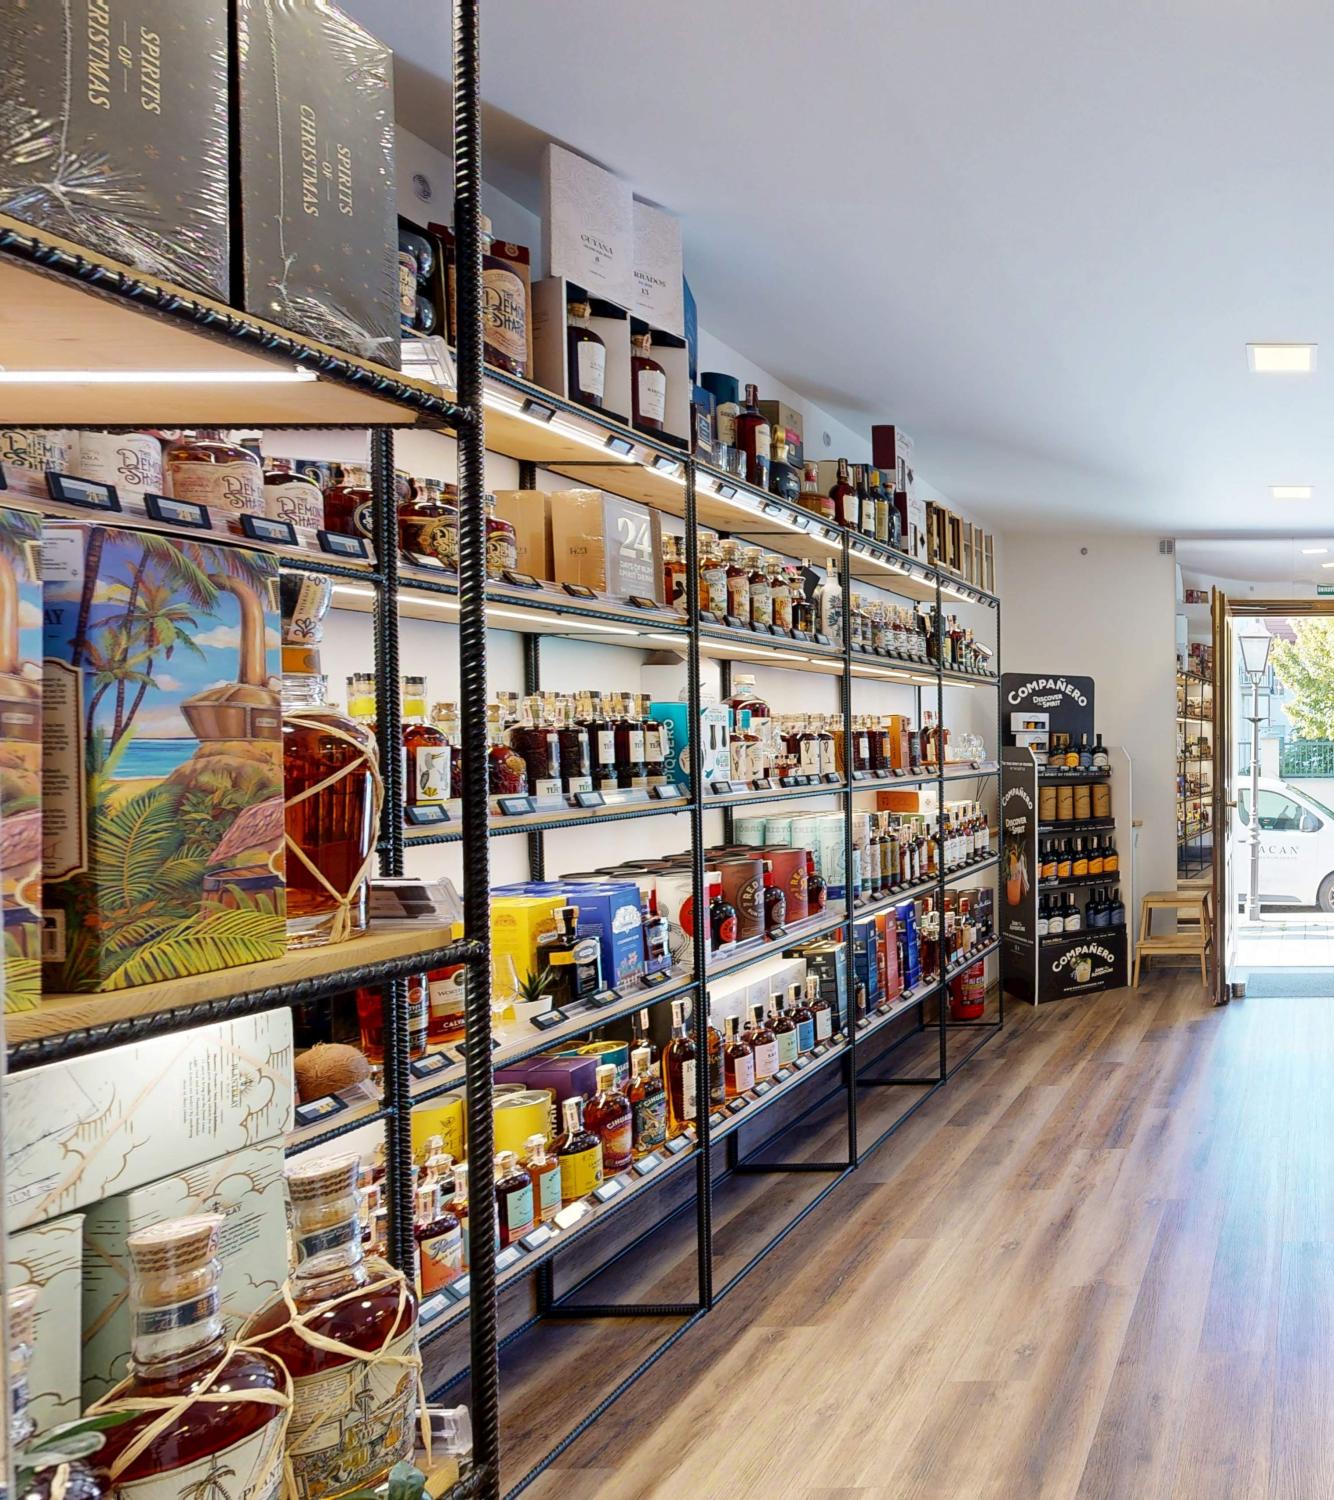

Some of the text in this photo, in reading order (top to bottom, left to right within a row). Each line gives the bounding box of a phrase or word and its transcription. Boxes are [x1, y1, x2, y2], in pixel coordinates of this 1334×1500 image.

[117, 45, 132, 69] OF
[140, 26, 161, 115] SPIRITS
[300, 104, 319, 216] CHRISTMAS
[321, 161, 333, 180] OF
[337, 143, 353, 216] SPIRITS
[617, 517, 652, 562] 24
[1008, 677, 1087, 707] COMPAÑERO
[1033, 694, 1063, 704] DISCOVER
[1042, 700, 1061, 708] SPIRIT
[1001, 787, 1033, 811] COMPAÑERO
[1052, 942, 1115, 972] COMPAÑERO
